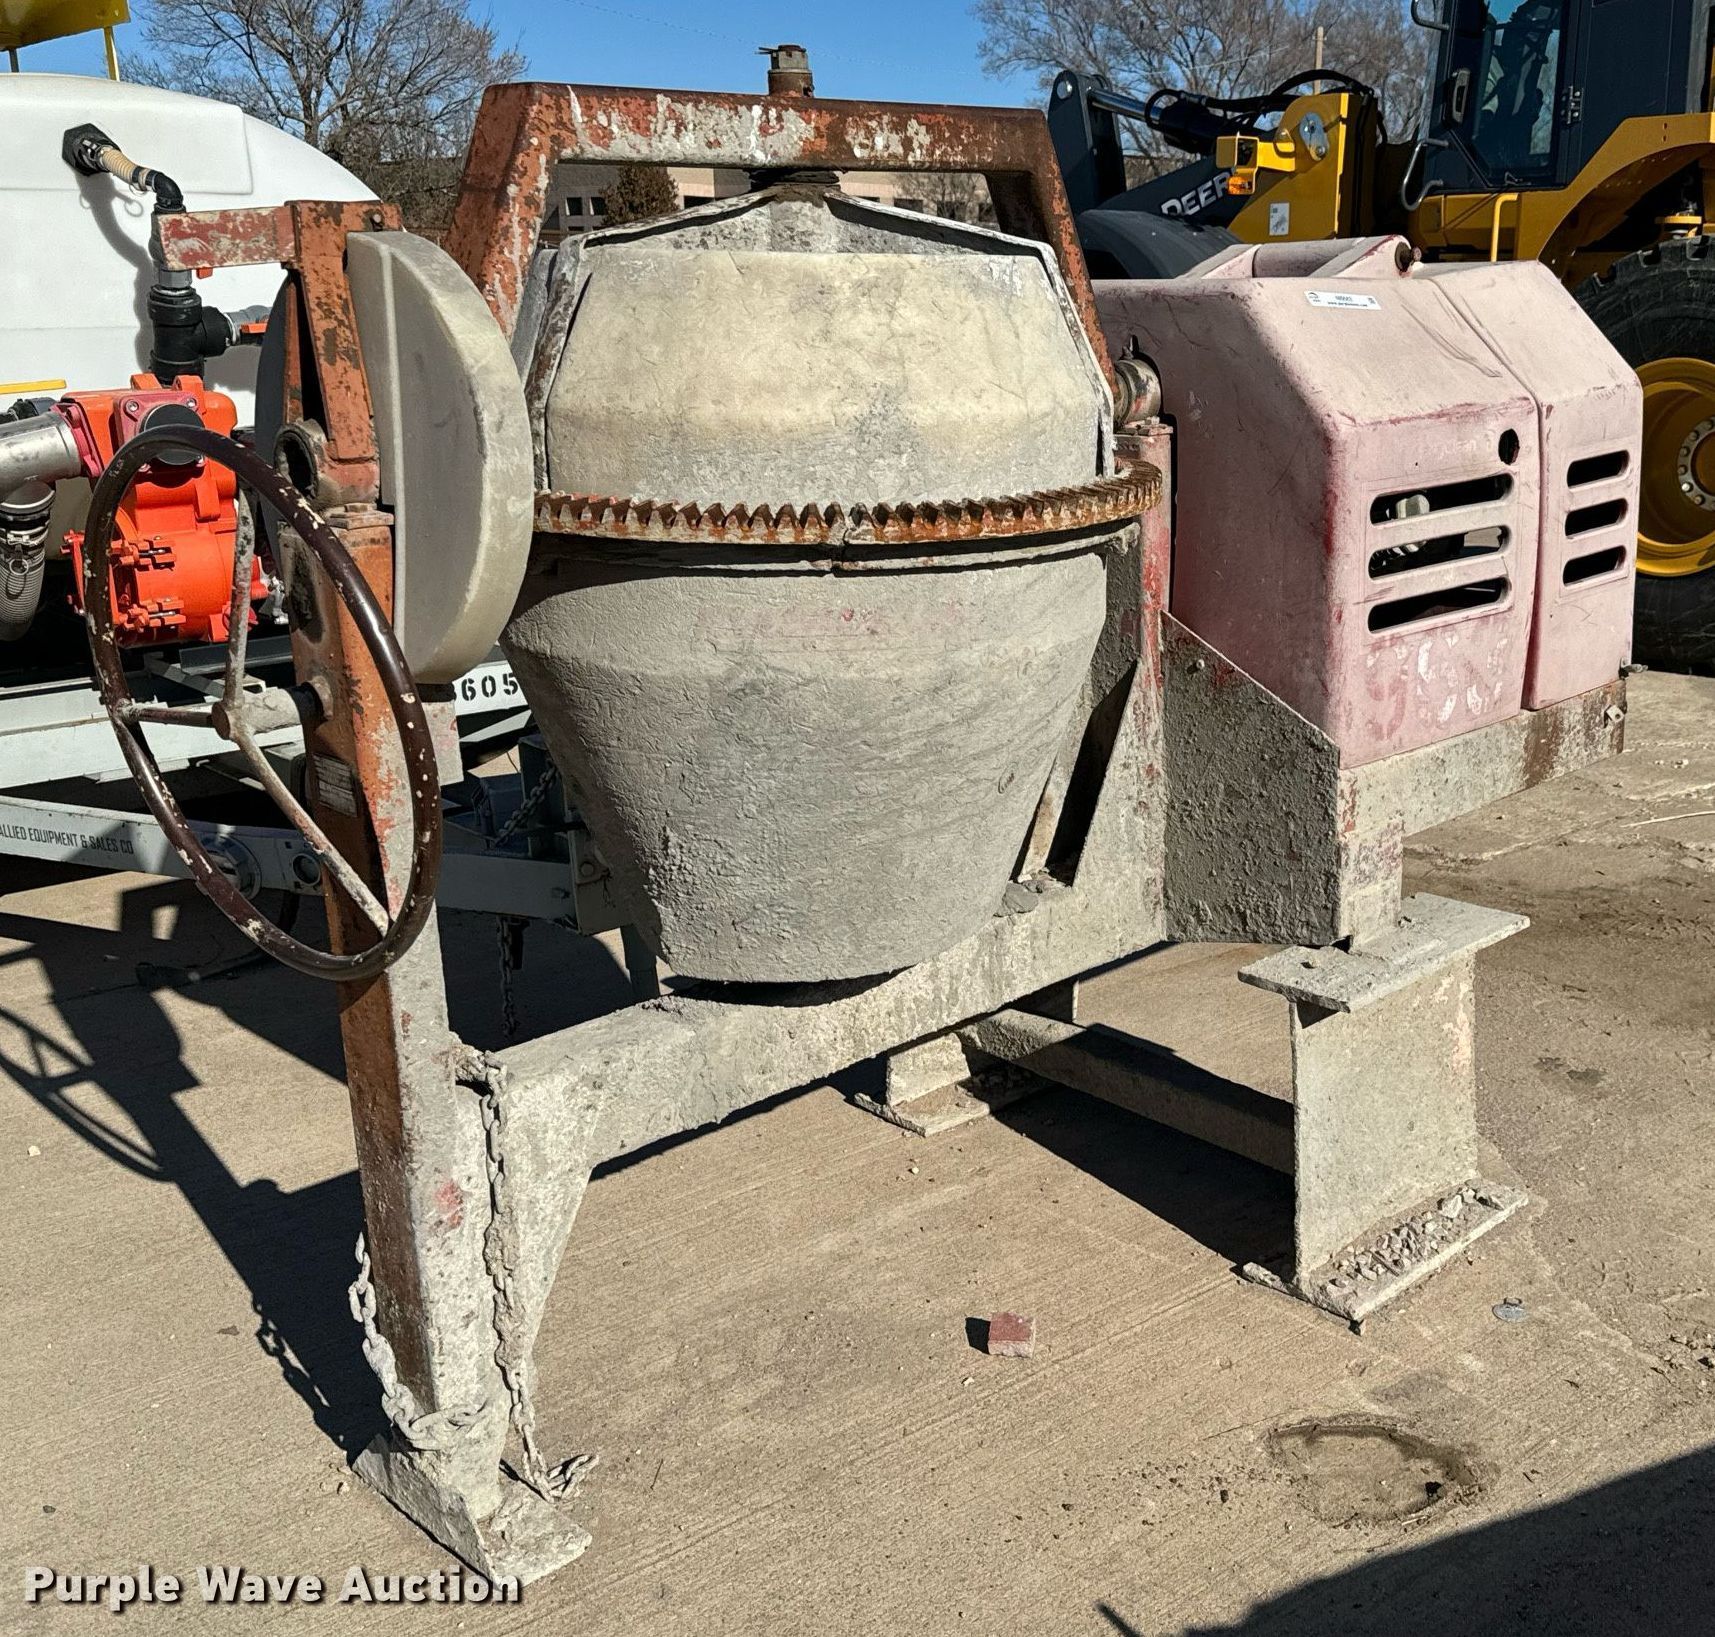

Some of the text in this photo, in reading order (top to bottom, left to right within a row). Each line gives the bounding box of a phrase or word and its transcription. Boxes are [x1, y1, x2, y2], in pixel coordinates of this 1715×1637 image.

[1160, 171, 1231, 216] DEER
[0, 824, 134, 855] ALLIED EQUIPMENT & SALES CO
